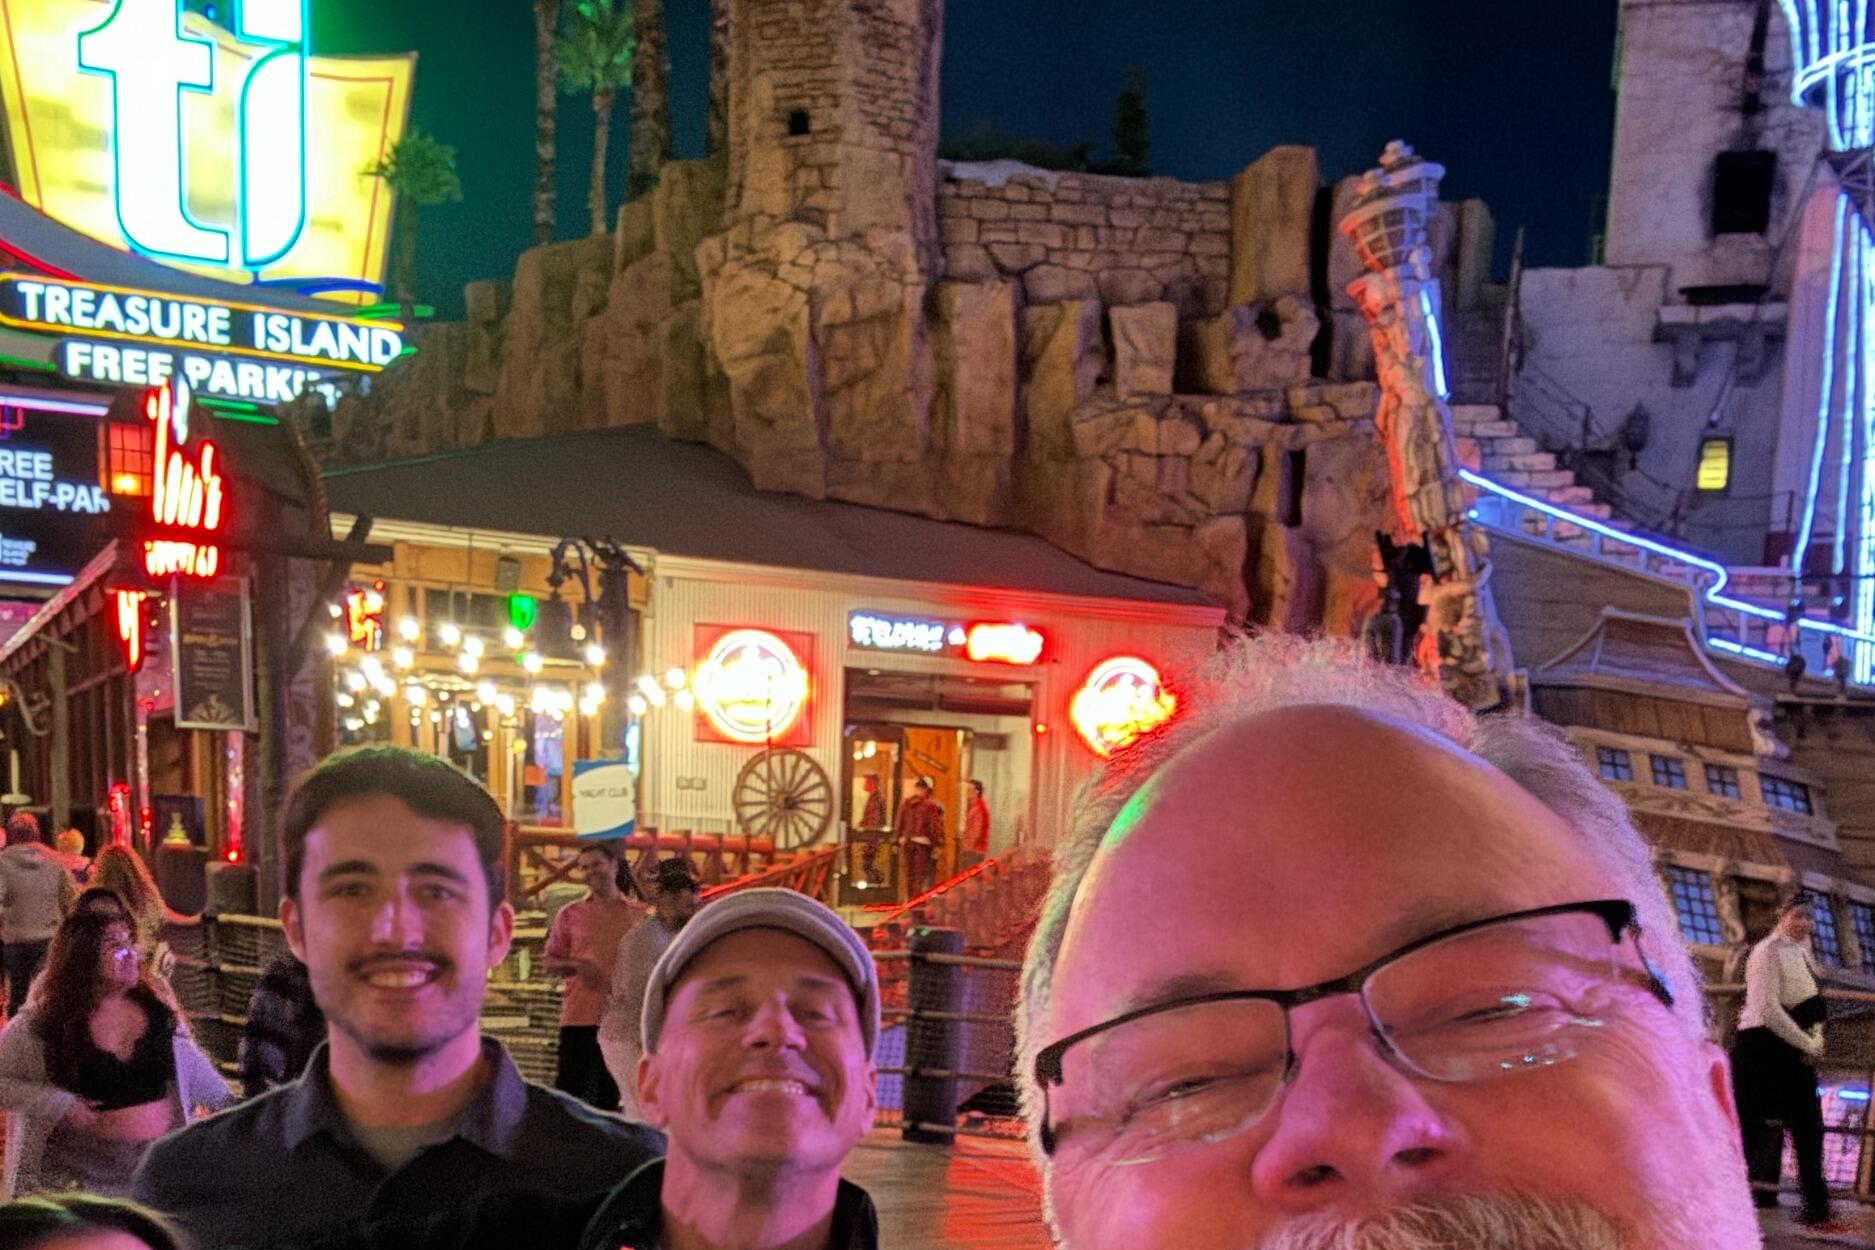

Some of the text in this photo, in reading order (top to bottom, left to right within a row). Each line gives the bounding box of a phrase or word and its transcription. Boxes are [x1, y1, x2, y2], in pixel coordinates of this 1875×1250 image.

[16, 281, 402, 366] TREASURE ISLAND
[66, 341, 174, 387] FREE
[0, 448, 54, 481] REE
